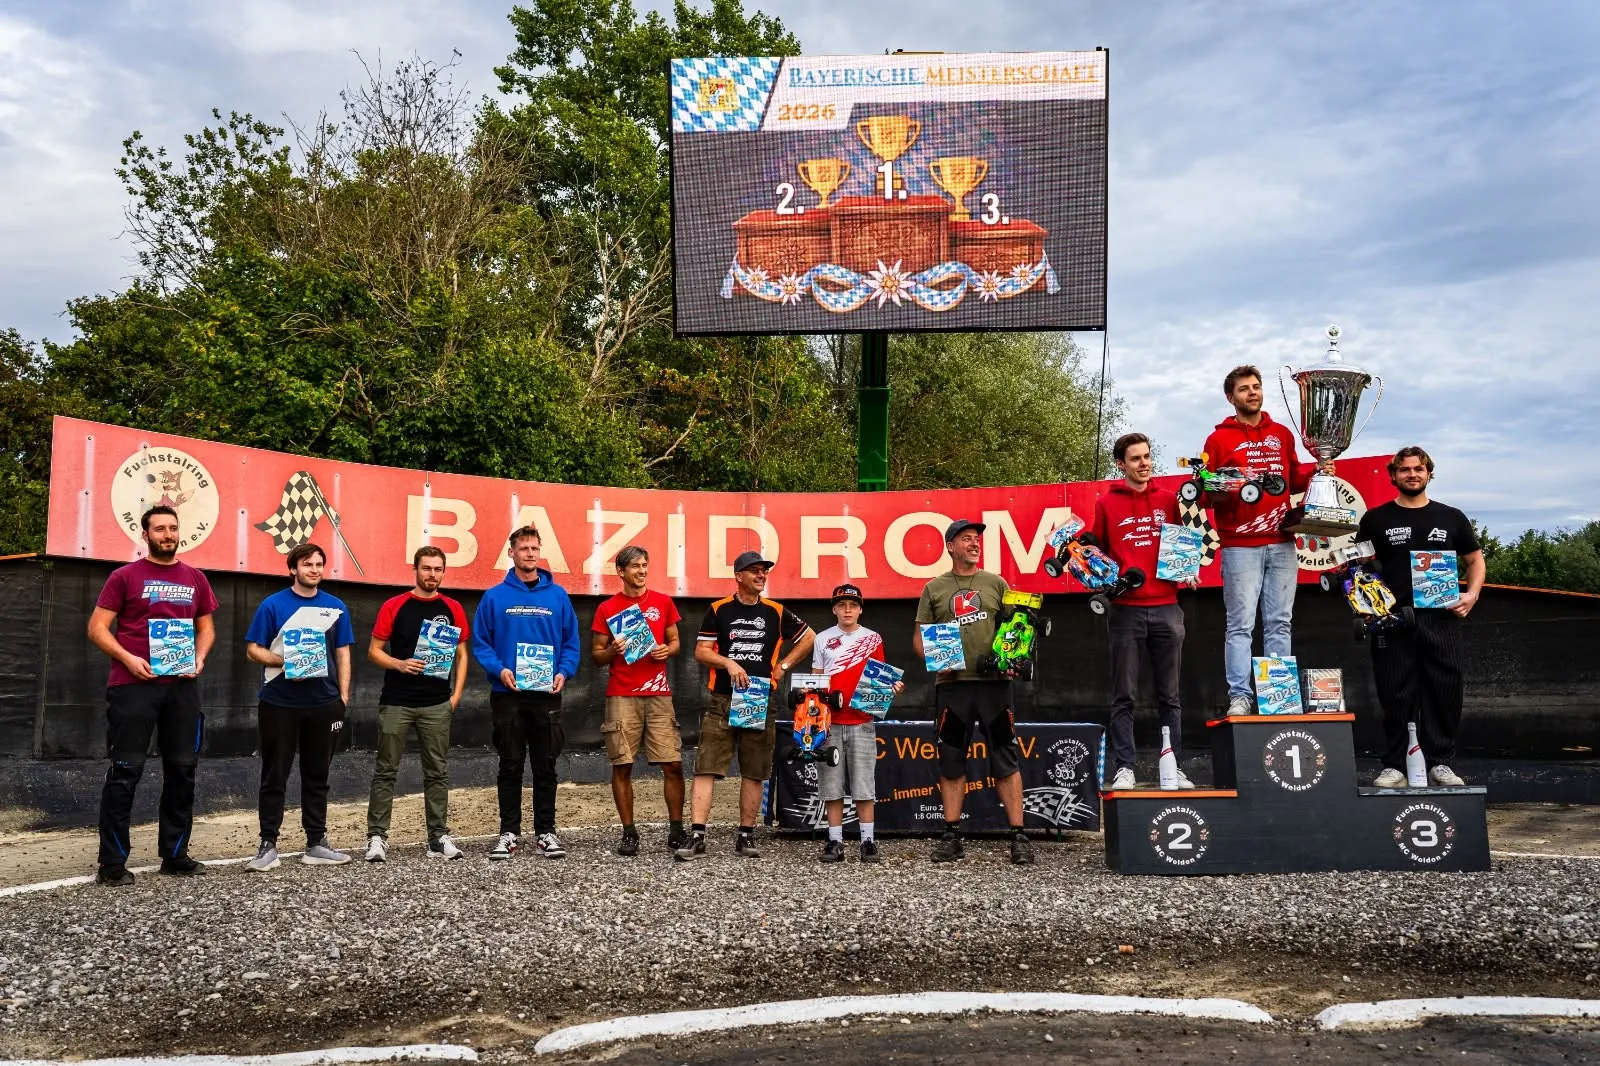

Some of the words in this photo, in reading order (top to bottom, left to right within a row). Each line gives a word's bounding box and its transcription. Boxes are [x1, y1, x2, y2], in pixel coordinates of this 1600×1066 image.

[788, 67, 922, 85] BAYERISCHE
[926, 64, 1099, 84] MEISTERSCHAFT
[777, 103, 838, 122] 2026
[877, 159, 908, 201] 1.
[774, 181, 805, 216] 2.
[980, 192, 1010, 225] 3.
[123, 453, 209, 489] Fuchstalring
[122, 511, 138, 532] MC
[190, 521, 209, 541] e.V.
[406, 494, 1072, 580] BAZIDROM
[1167, 556, 1198, 571] 2026
[1296, 553, 1337, 567] Welde
[1423, 579, 1457, 599] 2026
[628, 627, 650, 653] 2026
[160, 646, 194, 666] 2026
[293, 651, 326, 670] 2026
[422, 653, 452, 664] 2026
[933, 646, 961, 664] 2026
[524, 668, 552, 683] 2026
[861, 693, 891, 702] 2026
[1266, 685, 1299, 705] 2026
[738, 704, 766, 717] 2026
[1047, 738, 1090, 756] Fuchstalring
[1266, 730, 1321, 750] Fuchstalring
[1285, 744, 1302, 778] 1
[1269, 770, 1280, 783] MC
[1281, 780, 1312, 791] Welden
[1312, 770, 1323, 784] e.V.
[893, 785, 934, 800] immer
[1152, 806, 1205, 826] Fuchstalring
[1396, 803, 1450, 823] Fuchstalring
[1167, 823, 1193, 850] 2
[1410, 820, 1439, 847] 3
[1154, 844, 1165, 857] MC
[1166, 855, 1196, 866] Welden
[1398, 842, 1410, 855] MC
[1411, 853, 1441, 864] Welden
